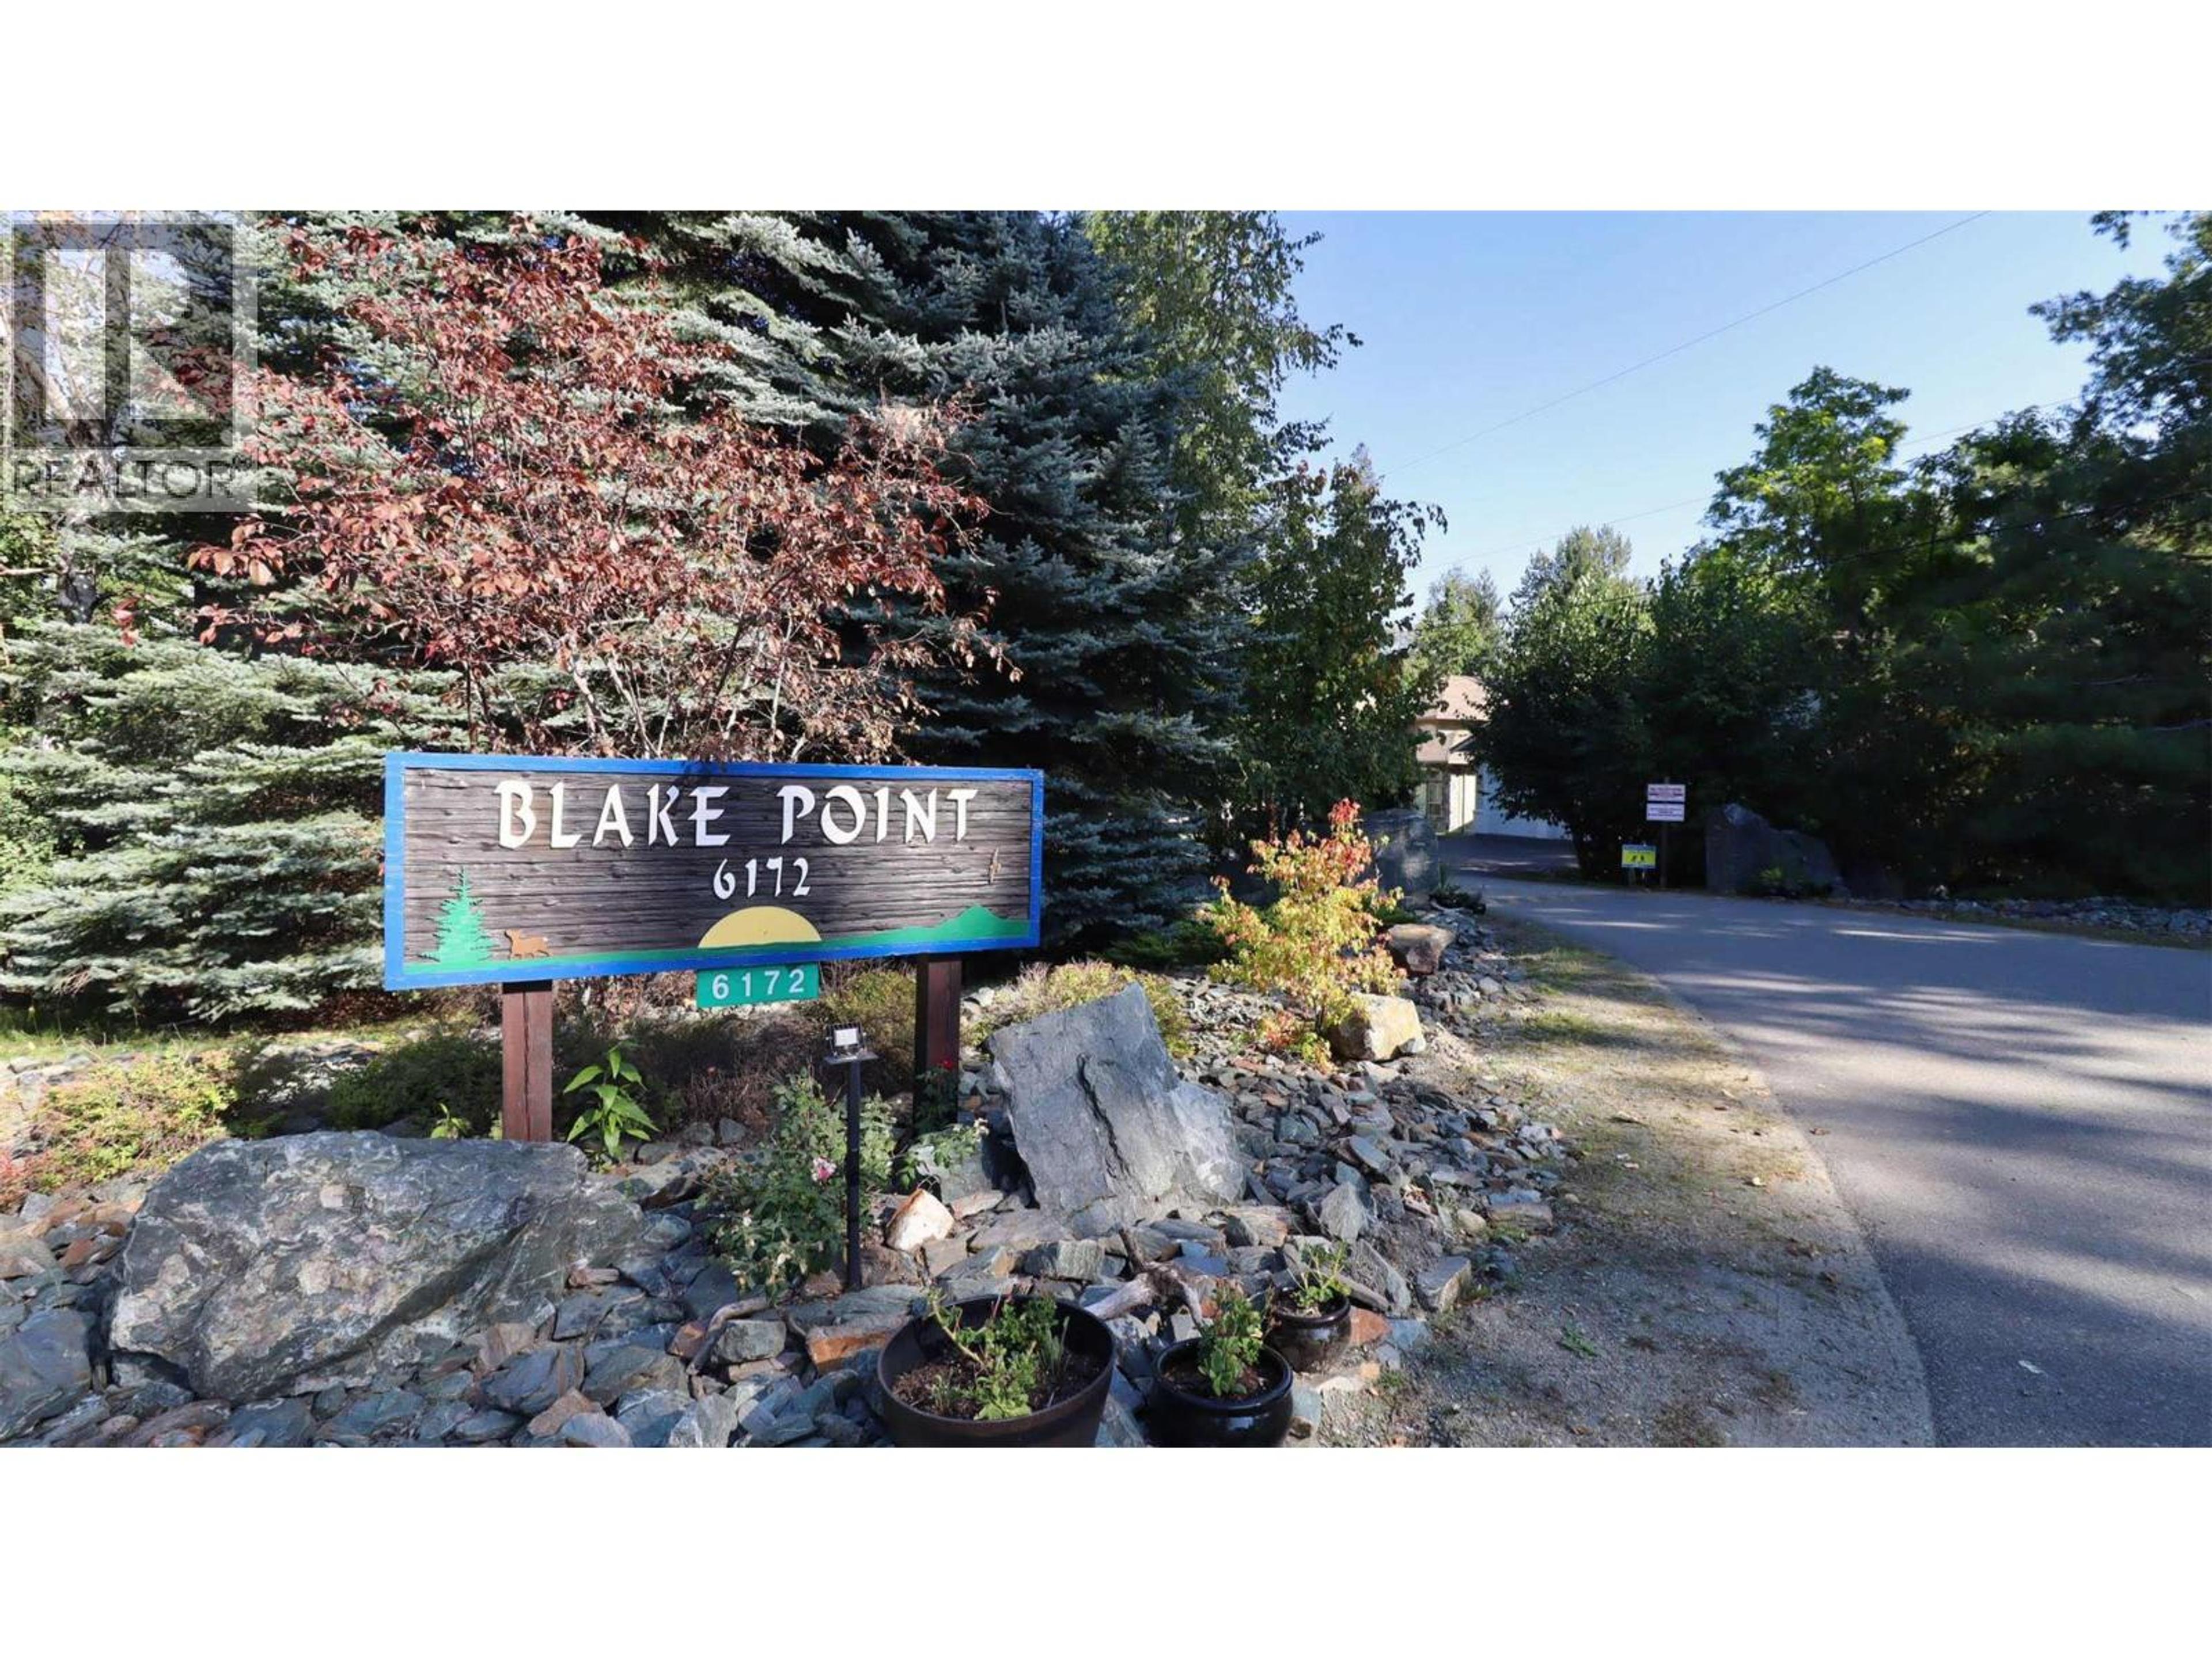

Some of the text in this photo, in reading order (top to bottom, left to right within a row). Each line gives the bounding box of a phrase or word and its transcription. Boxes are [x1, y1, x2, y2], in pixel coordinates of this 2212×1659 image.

[494, 779, 979, 849] BLAKE POINT
[713, 856, 811, 899] 6172
[712, 968, 805, 999] 6172
